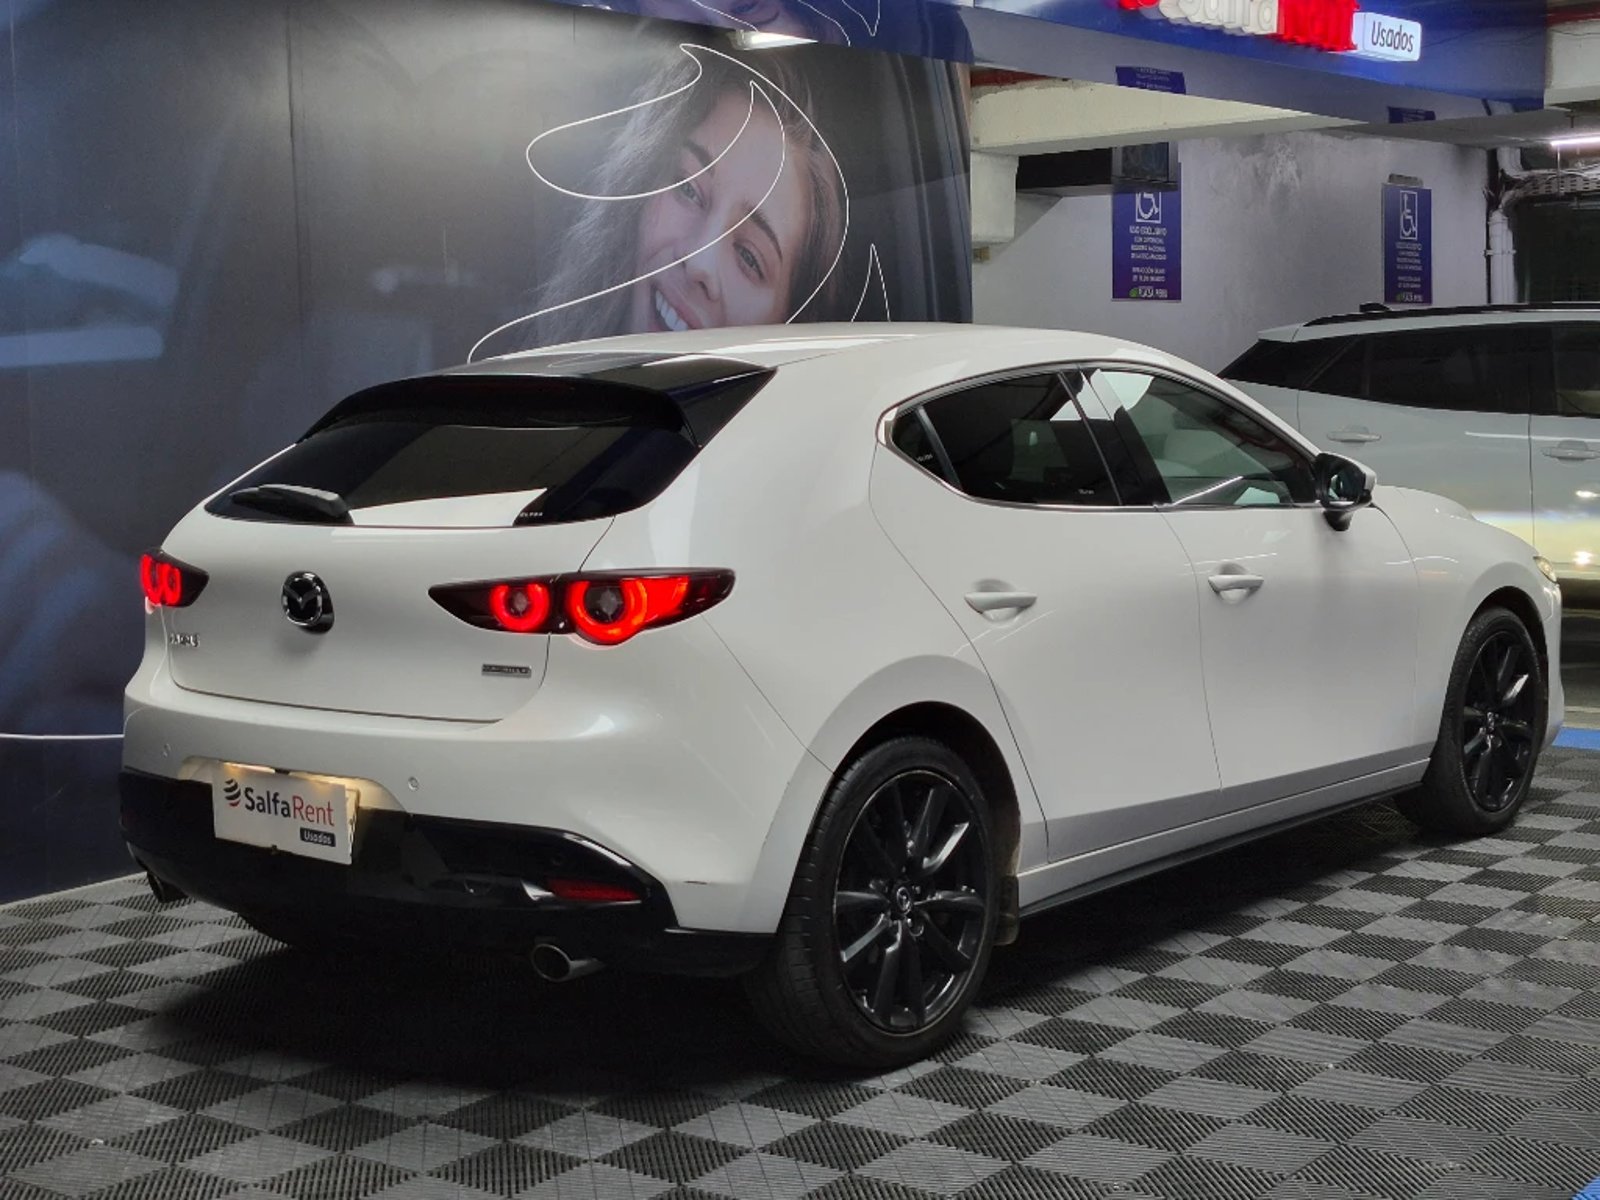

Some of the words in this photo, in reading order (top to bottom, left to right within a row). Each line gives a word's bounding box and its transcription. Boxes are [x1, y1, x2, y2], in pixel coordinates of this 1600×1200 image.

[1371, 21, 1414, 52] Usados
[244, 787, 335, 827] SalfaRent
[304, 830, 332, 845] Usados
